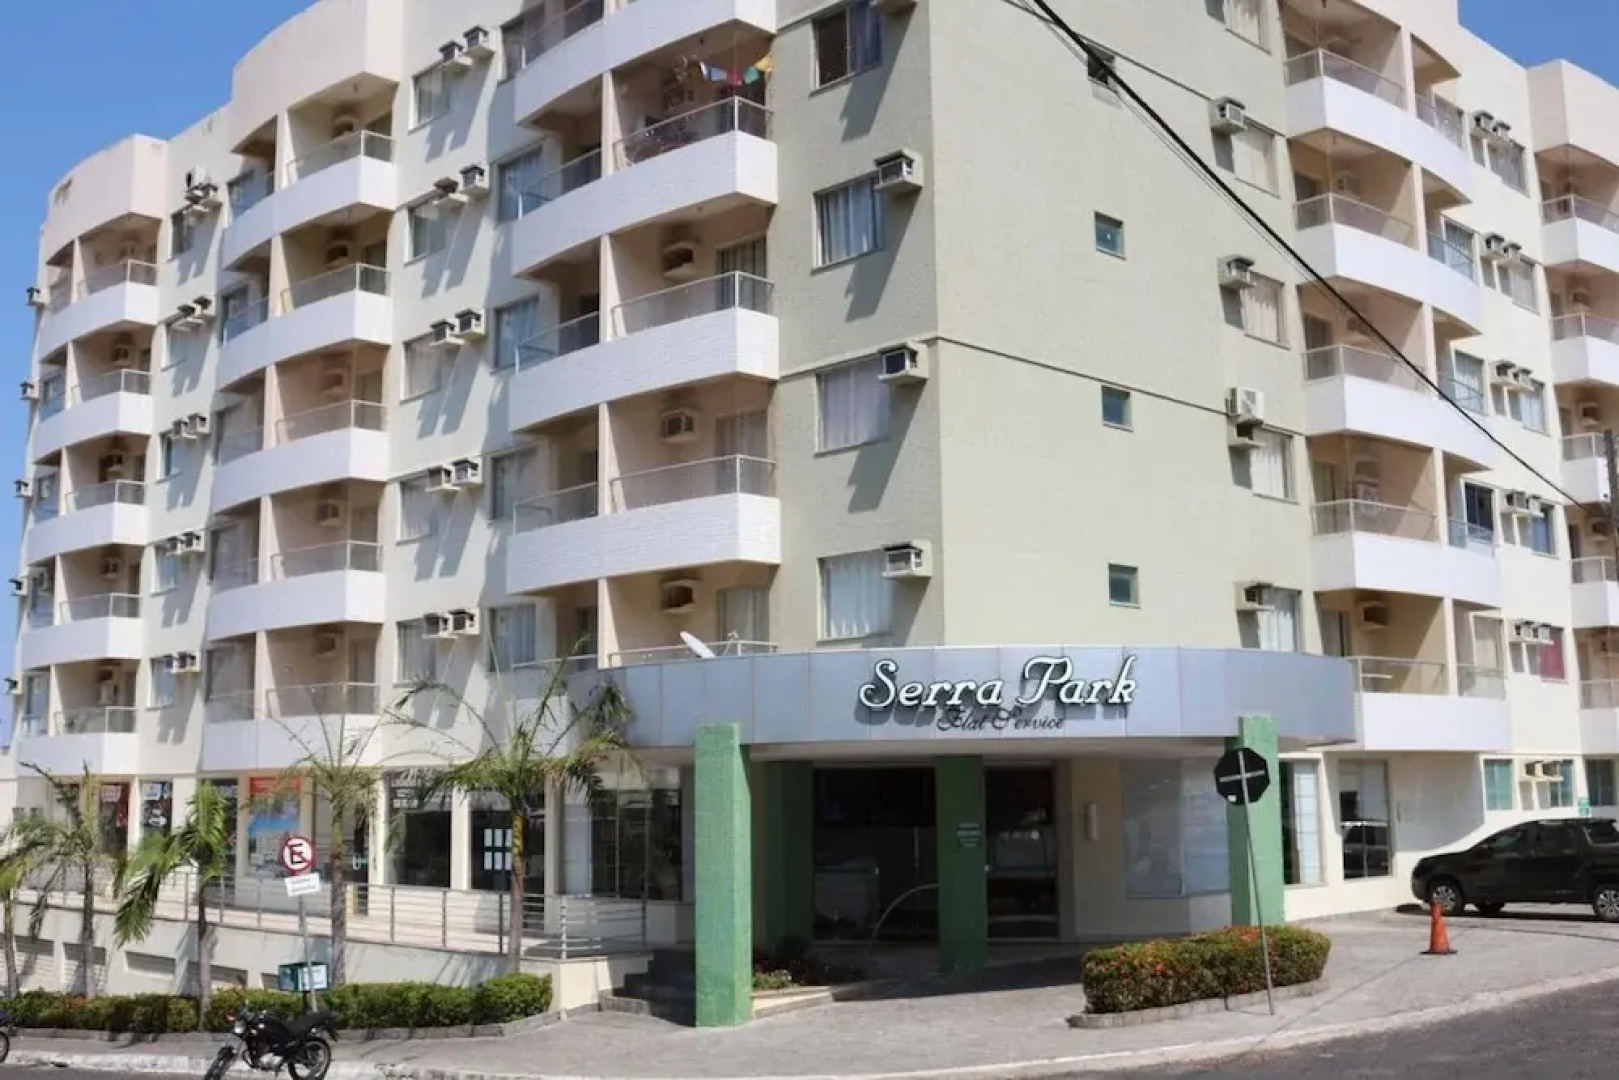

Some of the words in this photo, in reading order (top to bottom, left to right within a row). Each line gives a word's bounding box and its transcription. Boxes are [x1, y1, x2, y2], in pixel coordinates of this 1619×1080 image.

[858, 658, 1003, 707] Serra
[1016, 654, 1138, 705] Park
[992, 705, 1064, 731] Service
[290, 842, 306, 866] E
